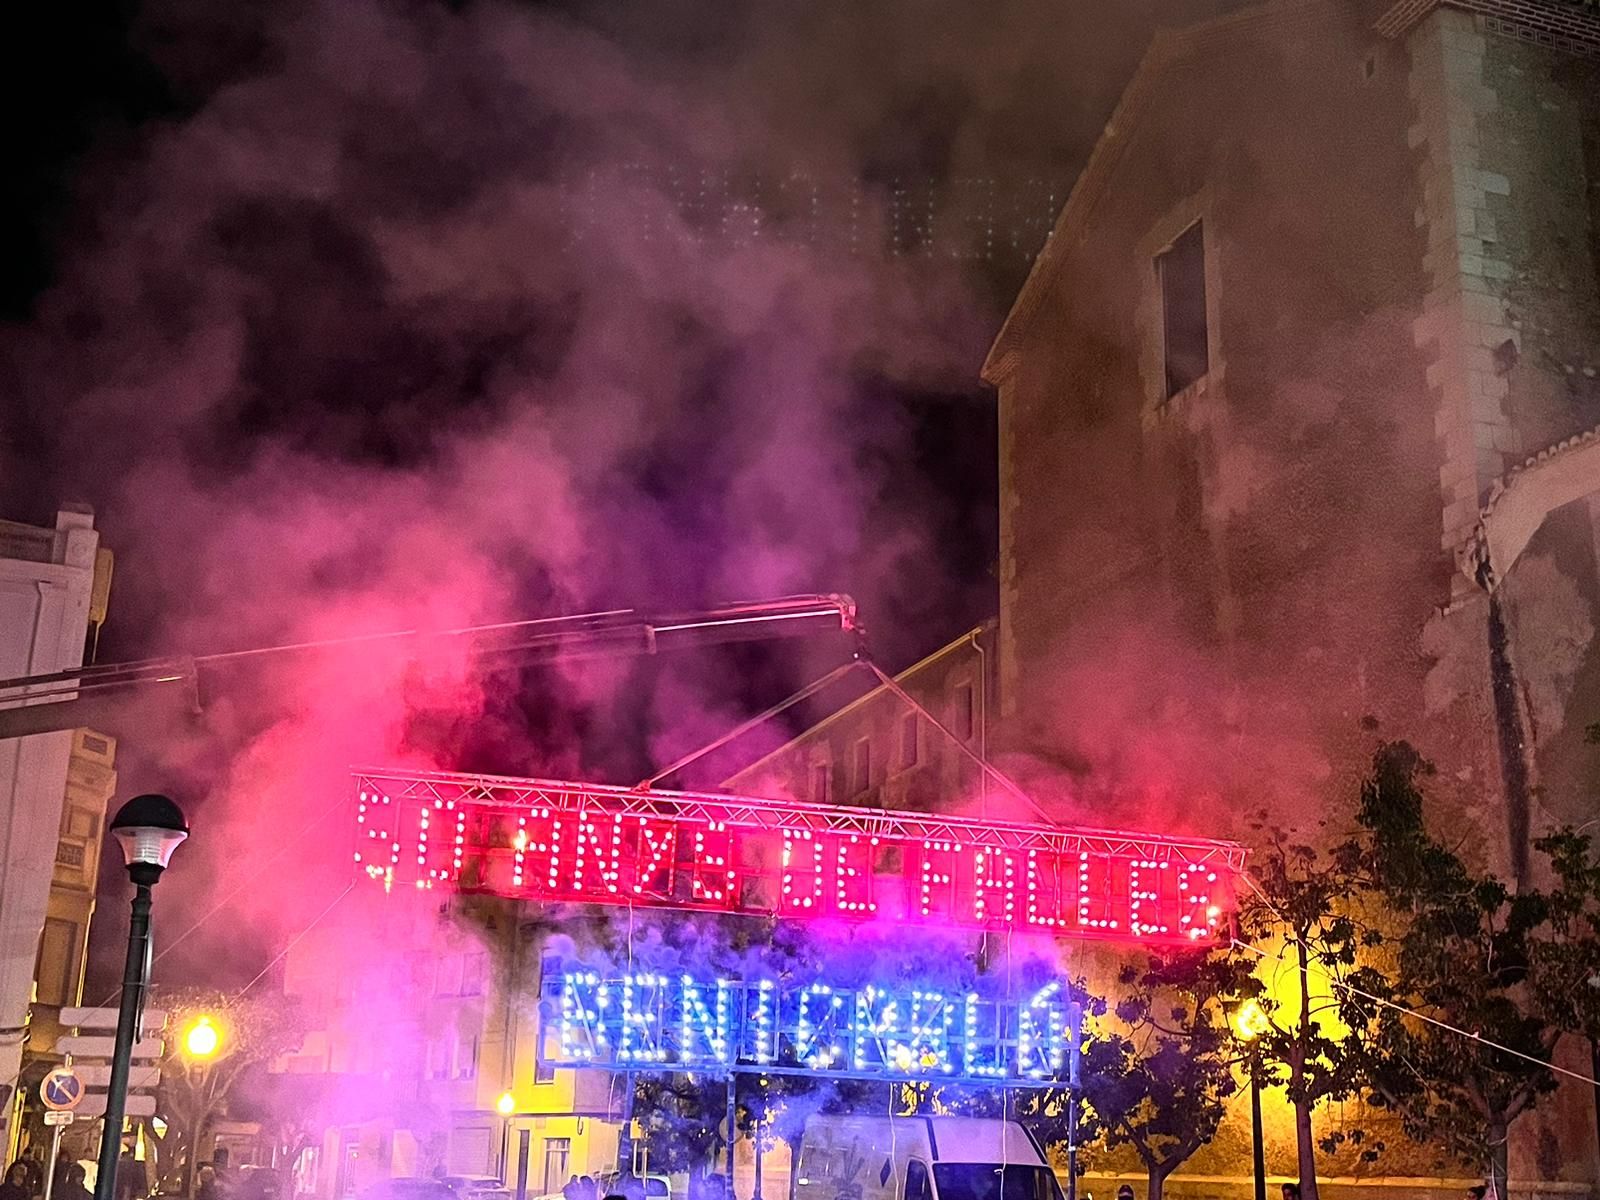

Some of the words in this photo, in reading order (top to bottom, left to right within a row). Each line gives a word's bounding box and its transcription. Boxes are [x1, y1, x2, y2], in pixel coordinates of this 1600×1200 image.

[512, 808, 738, 900] ANYS
[782, 829, 877, 909] DE
[920, 841, 1217, 938] FALLES
